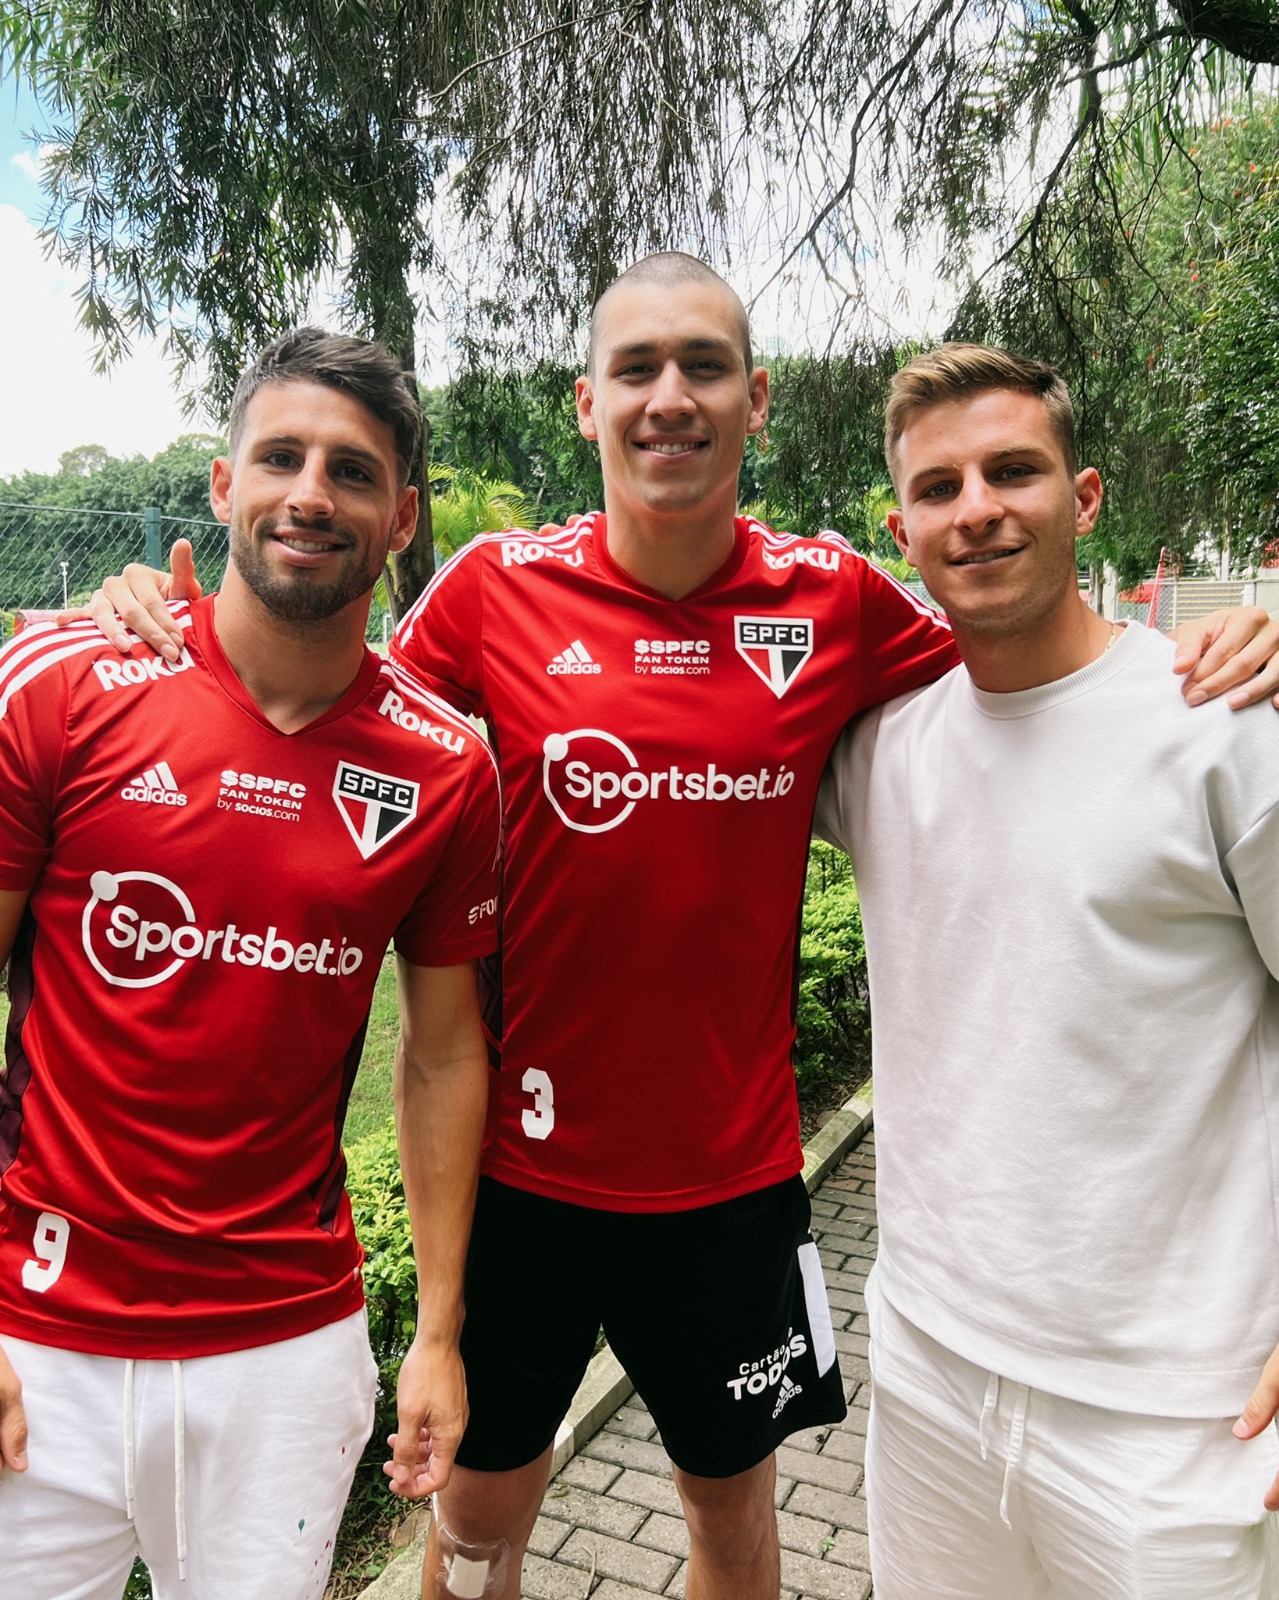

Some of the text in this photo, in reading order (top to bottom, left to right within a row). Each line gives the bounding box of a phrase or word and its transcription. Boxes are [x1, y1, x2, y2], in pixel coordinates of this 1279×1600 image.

[743, 625, 806, 644] SPFC
[634, 639, 711, 655] $SPFC
[546, 661, 602, 676] adidas
[634, 656, 710, 665] FAN TOKEN
[634, 664, 648, 676] by
[220, 769, 307, 799] $SPFC
[343, 772, 411, 806] SPFC
[564, 760, 795, 808] Sportsbet.io
[120, 785, 188, 807] adidas
[216, 796, 233, 811] by
[219, 787, 303, 811] FAN TOKEN
[105, 904, 364, 976] Sportsbet.io
[521, 1067, 555, 1140] 3
[21, 1211, 71, 1293] 9
